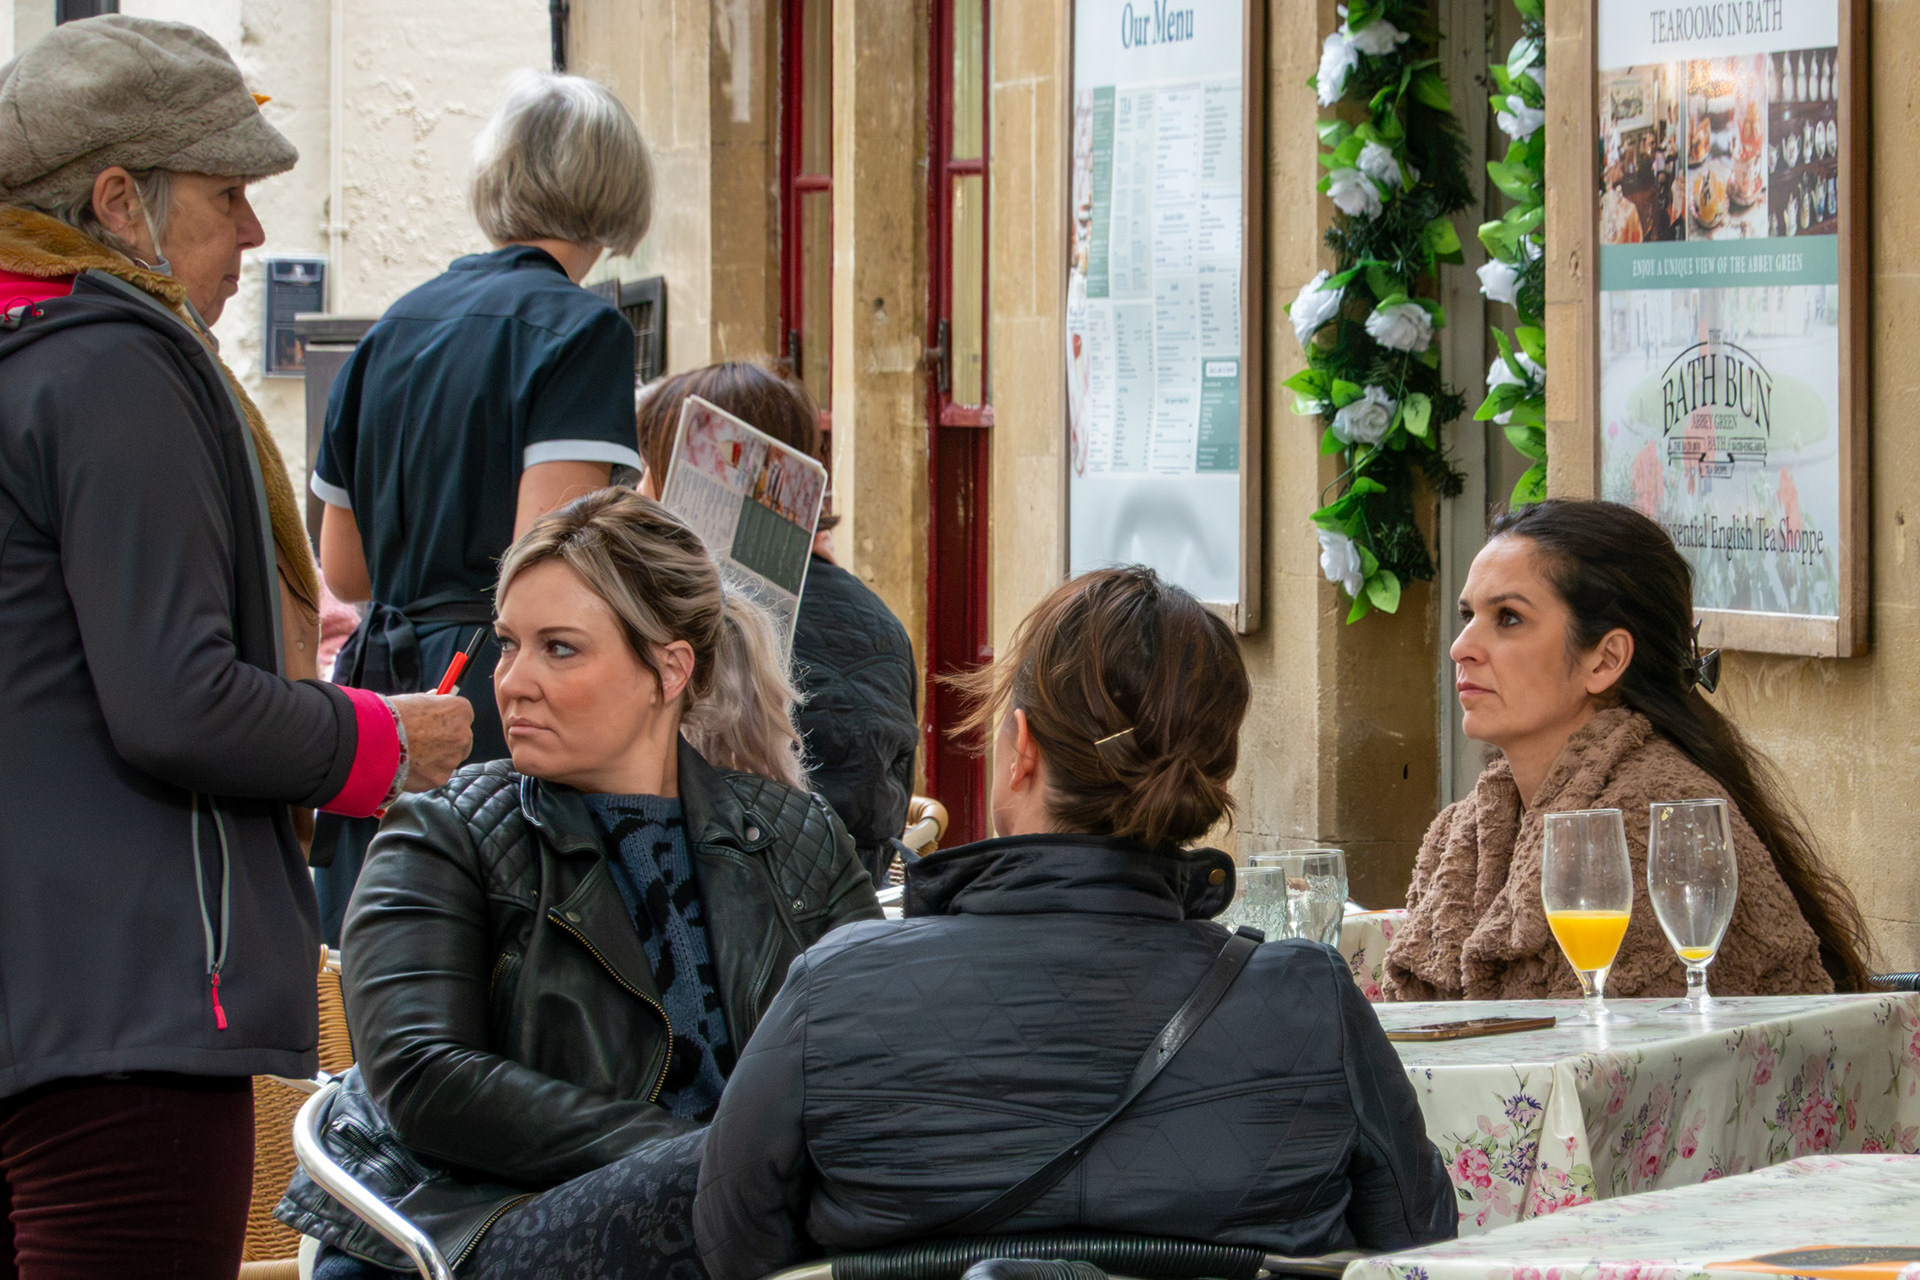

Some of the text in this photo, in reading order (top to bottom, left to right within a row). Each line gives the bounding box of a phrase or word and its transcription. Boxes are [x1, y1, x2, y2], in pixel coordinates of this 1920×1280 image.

[1121, 0, 1194, 49] Our Menu
[1650, 0, 1783, 44] TEAROOMS IN BATH
[1632, 253, 1803, 279] ENJOY A UNIQUE VIEW OF THE ABBEY GREEN
[1708, 329, 1721, 346] THE
[1662, 353, 1772, 439] BATH BUN
[1691, 413, 1738, 430] ABBEY GREEN
[1707, 435, 1727, 451] BATH
[1711, 514, 1753, 561] English
[1756, 517, 1777, 551] Tea
[1779, 516, 1824, 565] Shoppe
